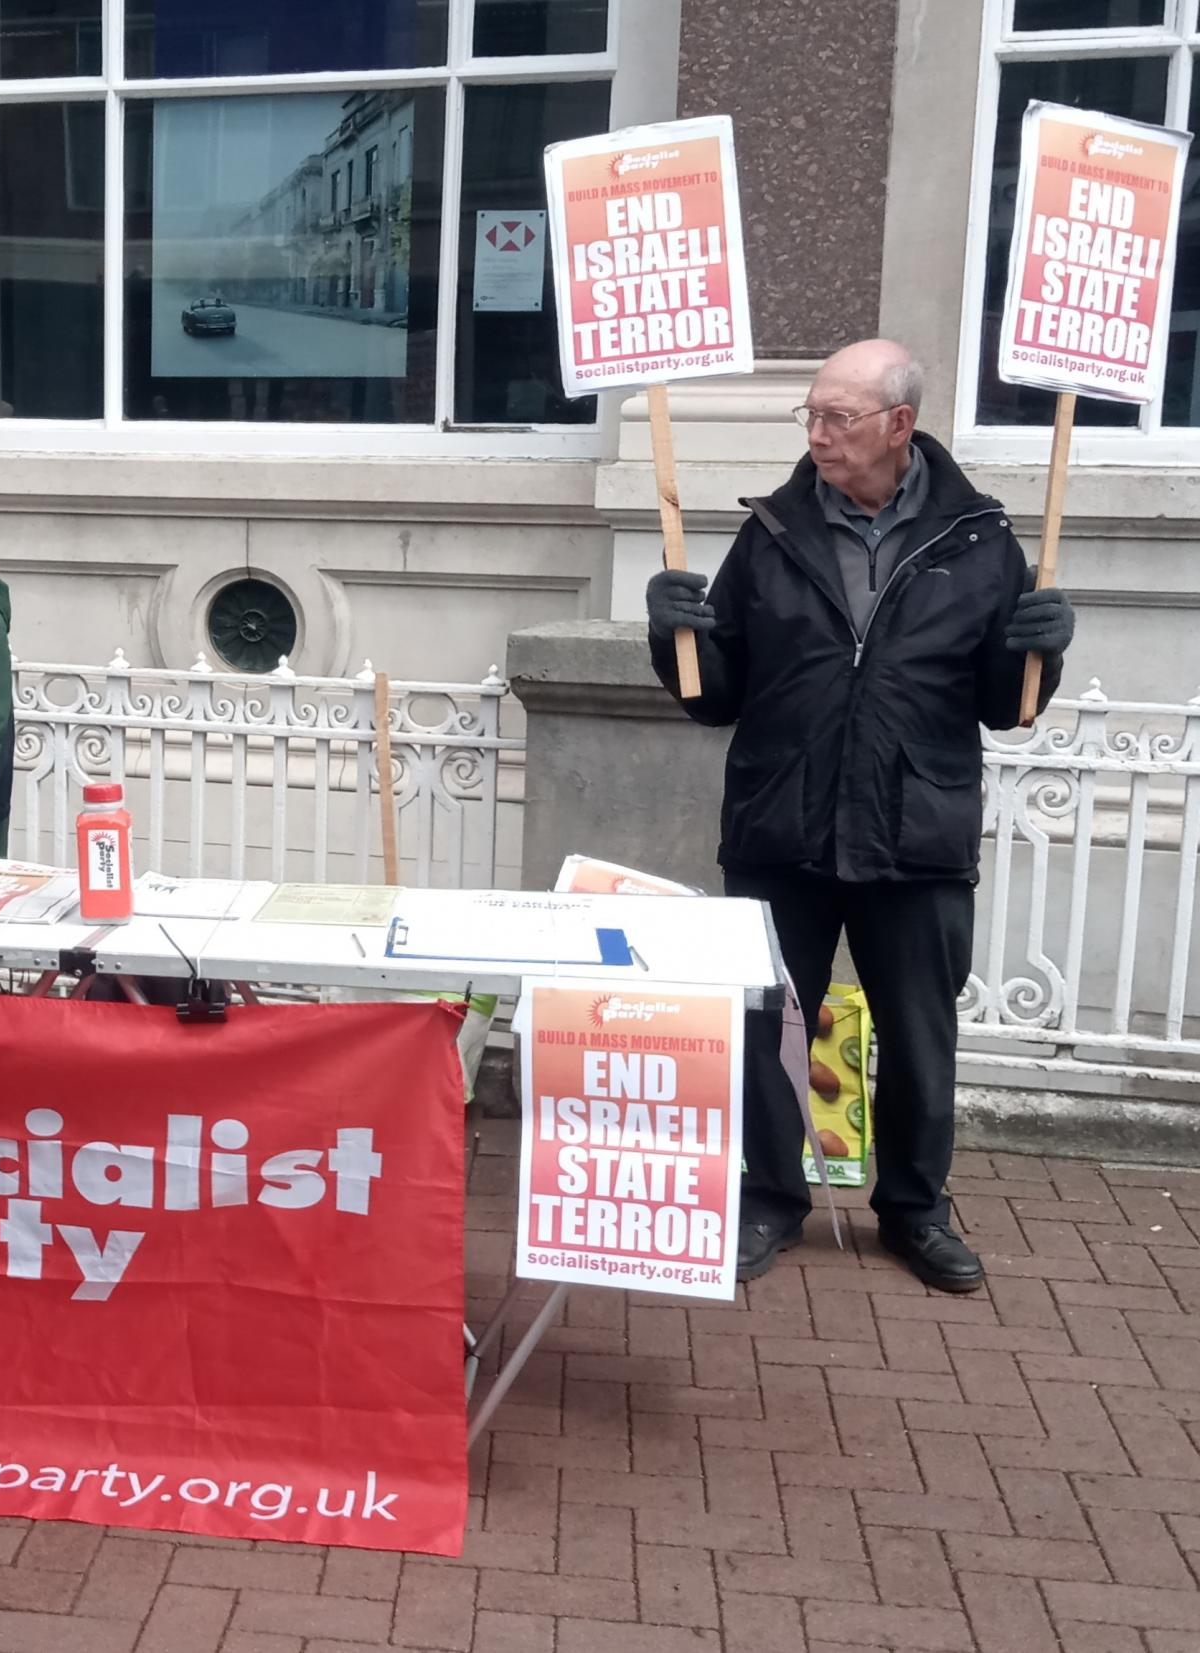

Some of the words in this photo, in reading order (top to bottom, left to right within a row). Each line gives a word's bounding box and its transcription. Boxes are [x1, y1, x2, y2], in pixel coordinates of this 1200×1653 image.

[618, 160, 659, 175] Party
[622, 150, 680, 165] Socialist
[1041, 155, 1068, 172] BUILD
[1070, 162, 1077, 173] A
[1080, 163, 1104, 180] MASS
[1106, 168, 1155, 190] MOVEMENT
[1157, 180, 1169, 194] TO
[568, 189, 599, 202] BUILD
[601, 187, 608, 197] A
[610, 182, 641, 196] MASS
[643, 173, 701, 191] MOVEMENT
[704, 171, 718, 183] TO
[1068, 176, 1135, 230] END
[605, 192, 682, 237] END
[572, 225, 722, 282] ISRAELI
[1031, 213, 1160, 279] ISRAELI
[591, 268, 708, 318] STATE
[1041, 259, 1141, 319] STATE
[574, 306, 730, 361] TERROR
[1019, 299, 1151, 364] TERROR
[575, 350, 735, 380] socialistparty.org.uk
[1011, 348, 1145, 385] socialistparty.org.uk
[96, 841, 106, 872] Party
[105, 844, 115, 888] Socialist
[602, 1008, 654, 1022] Party
[608, 997, 681, 1014] Socialist
[537, 1030, 575, 1045] BUILD
[578, 1032, 587, 1046] A
[590, 1032, 628, 1048] MASS
[631, 1035, 705, 1051] MOVEMENT
[708, 1039, 725, 1054] TO
[583, 1051, 677, 1102] END
[540, 1096, 722, 1155] ISRAELI
[557, 1146, 700, 1205] STATE
[809, 1163, 846, 1176] ADA
[531, 1194, 723, 1260] TERROR
[528, 1250, 722, 1285] socialistparty.org.uk
